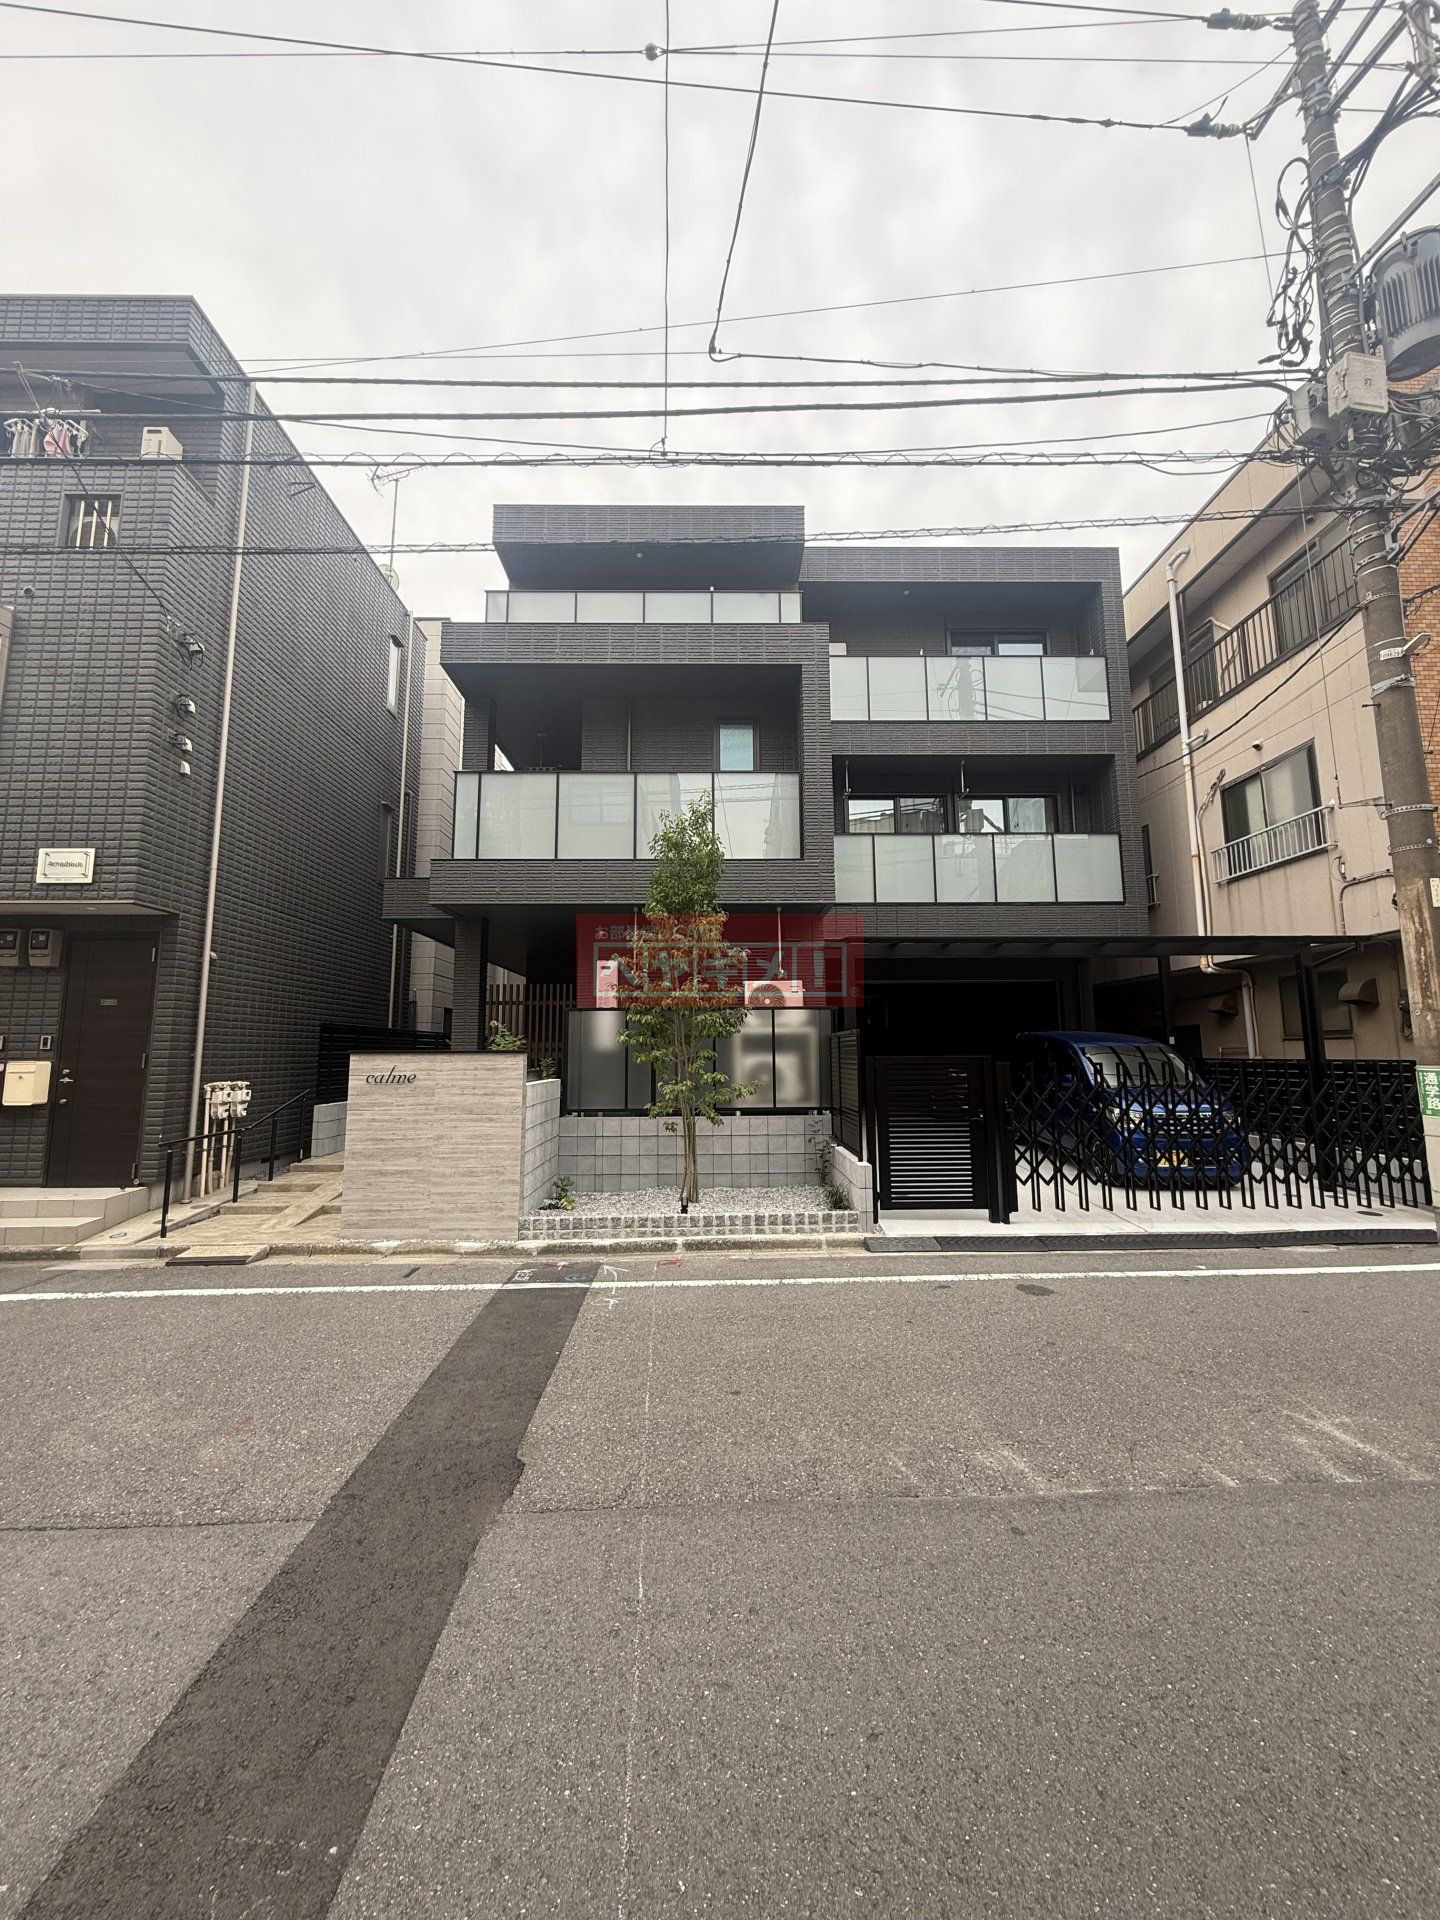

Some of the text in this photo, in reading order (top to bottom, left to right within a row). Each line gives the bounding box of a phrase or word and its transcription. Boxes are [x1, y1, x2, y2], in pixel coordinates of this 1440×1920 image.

[365, 1064, 417, 1084] calme
[1423, 1072, 1440, 1110] 通学路
